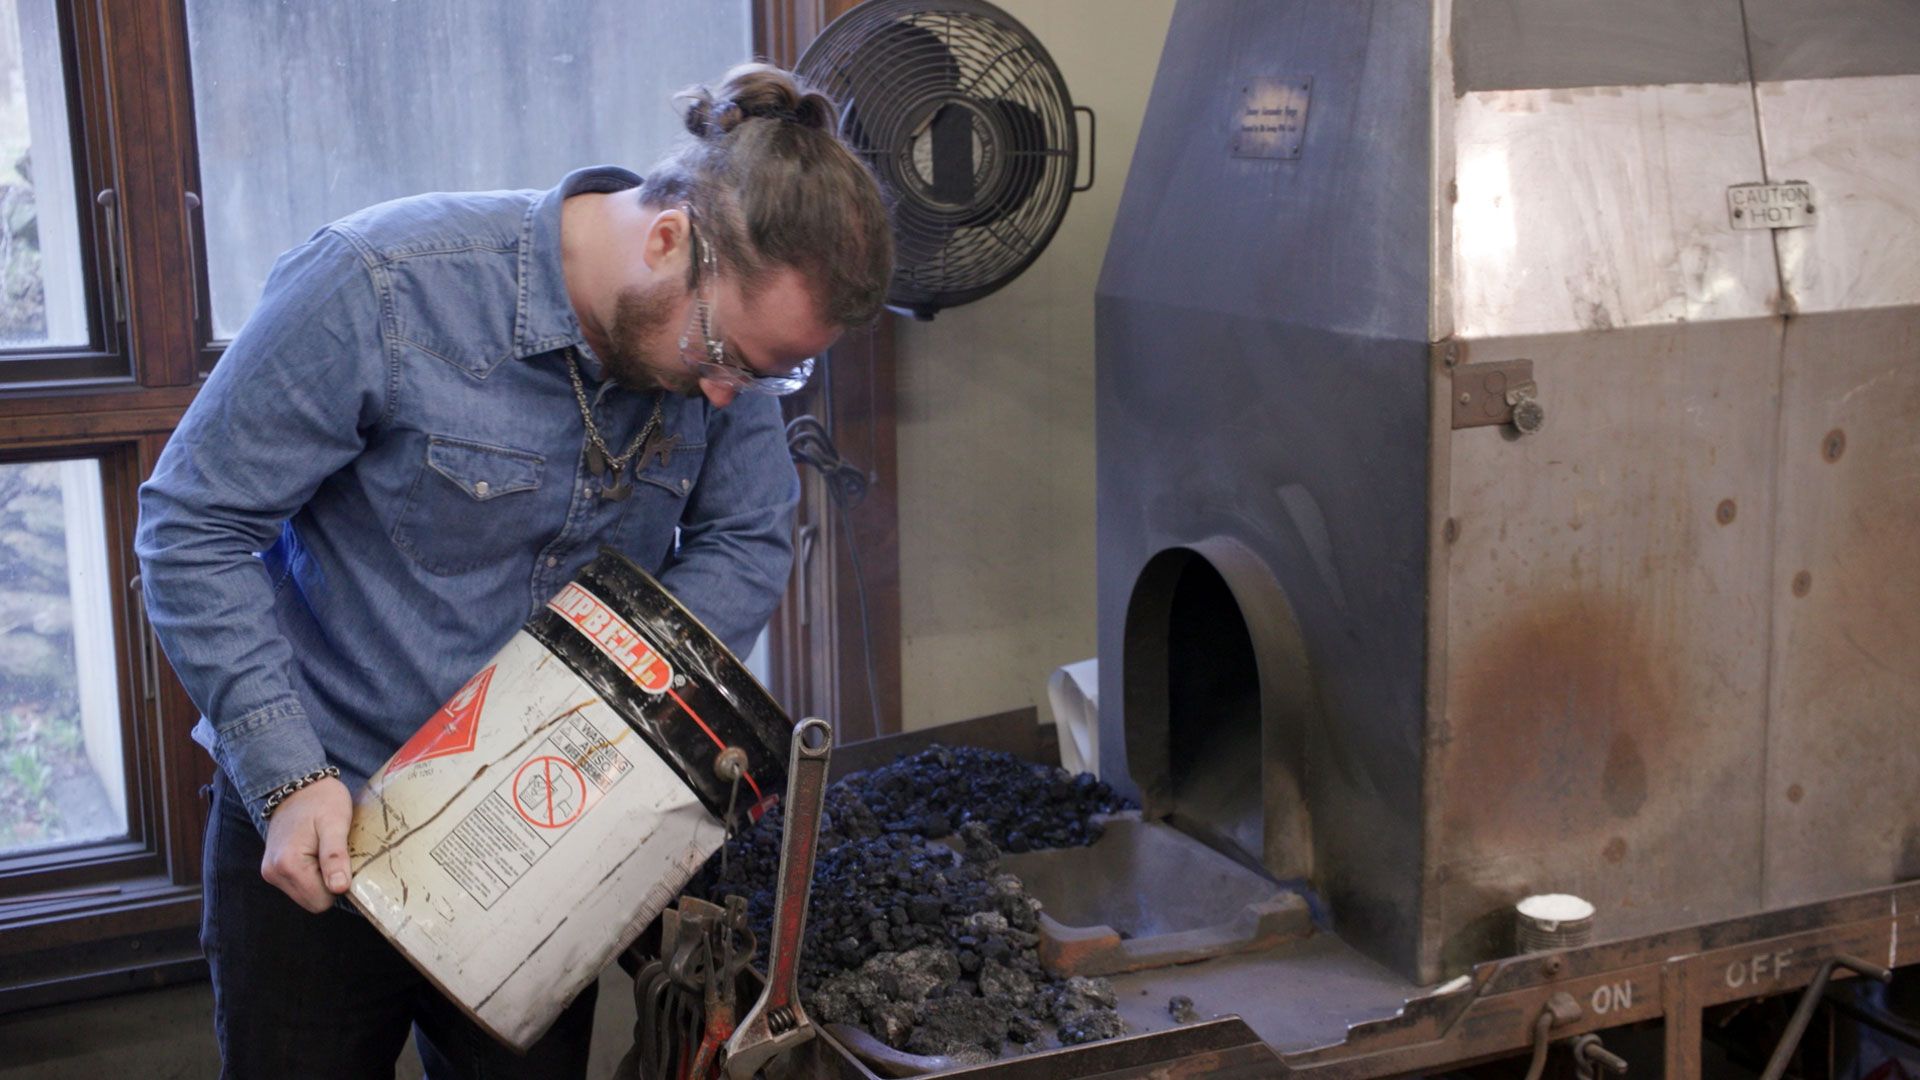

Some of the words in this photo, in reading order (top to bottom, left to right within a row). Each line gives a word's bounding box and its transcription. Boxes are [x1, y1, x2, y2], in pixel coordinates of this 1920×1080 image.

[1732, 187, 1809, 206] CAUTION
[1750, 206, 1794, 222] HOT
[581, 722, 629, 772] WARNING
[1725, 948, 1794, 988] OFF
[1591, 979, 1633, 1014] ON
